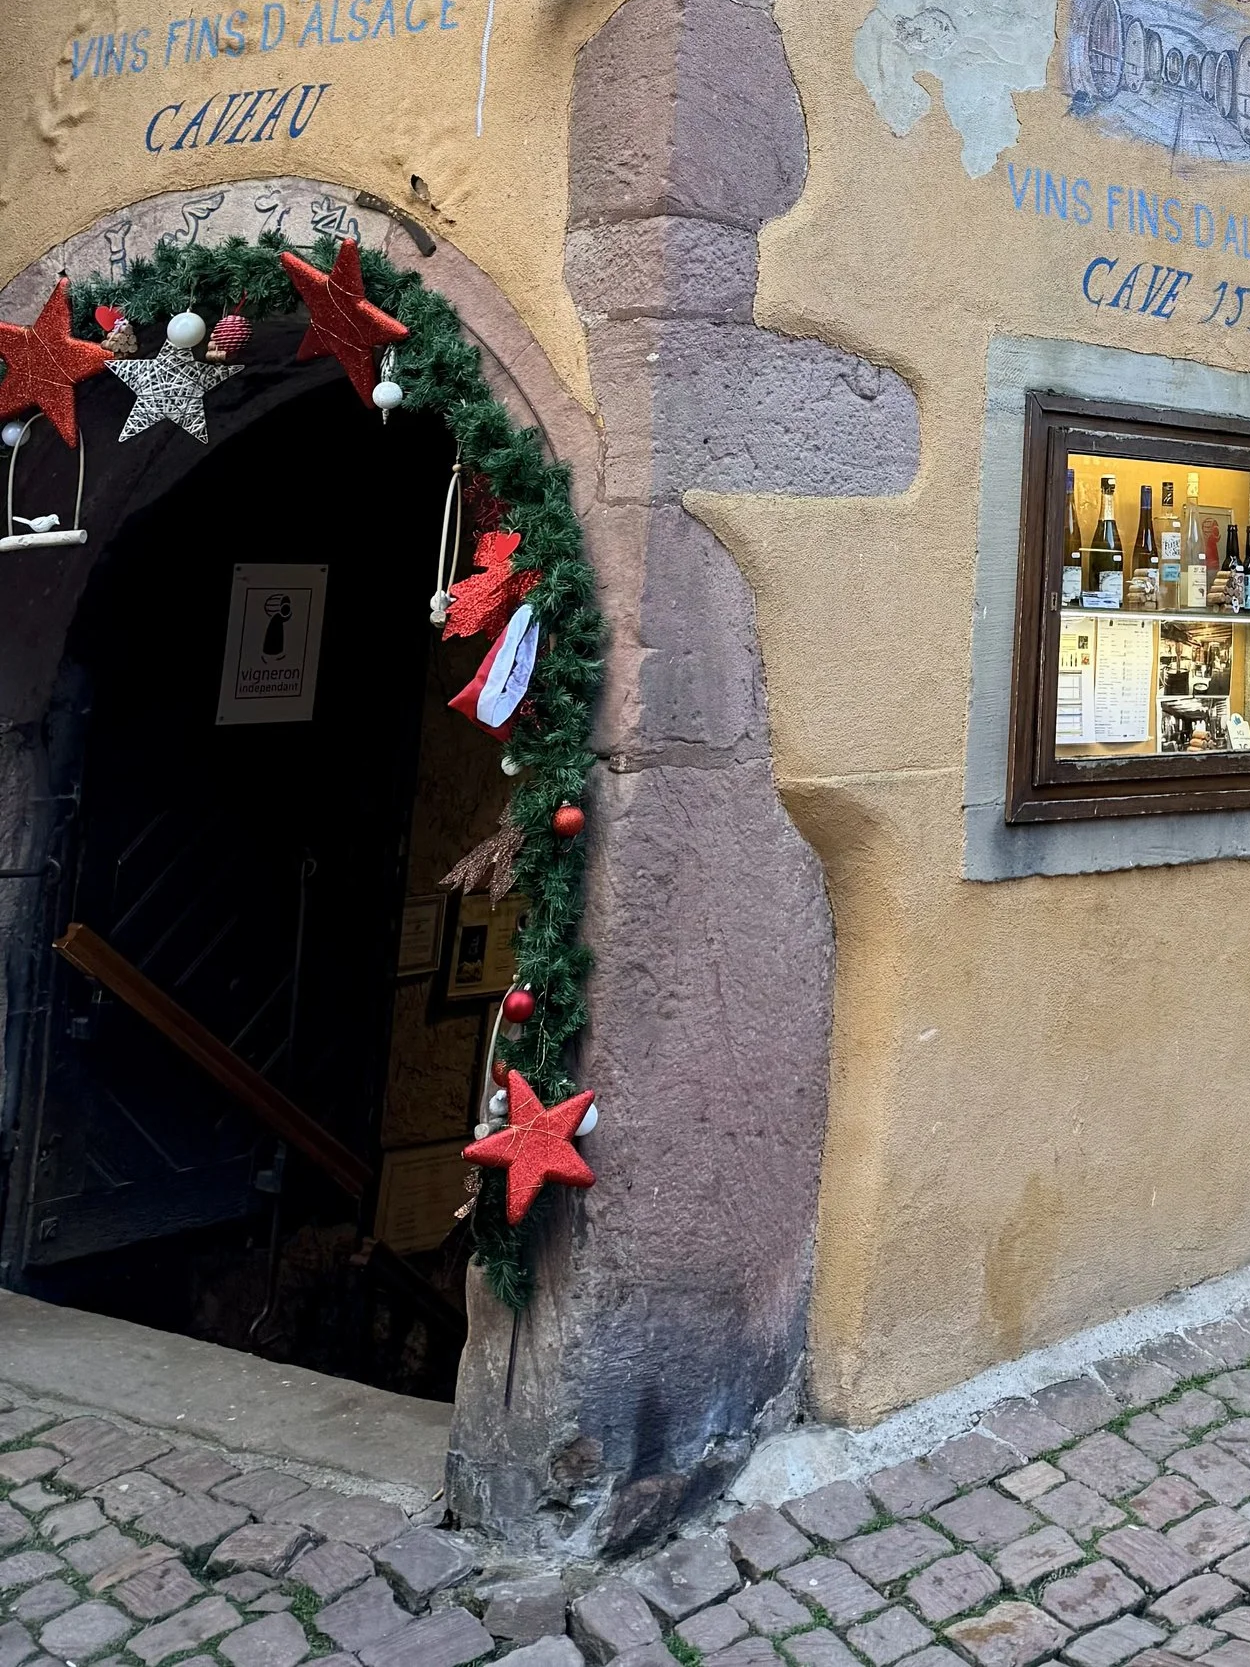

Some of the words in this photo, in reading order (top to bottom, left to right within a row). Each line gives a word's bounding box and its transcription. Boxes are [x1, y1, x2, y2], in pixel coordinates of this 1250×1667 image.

[70, 27, 150, 81] VINS
[164, 9, 248, 71] FINS
[145, 82, 332, 155] CAVEAU
[1007, 162, 1094, 226] VINS
[1106, 184, 1184, 246] FINS
[1081, 256, 1193, 319] CAVE
[241, 667, 300, 684] vigneron
